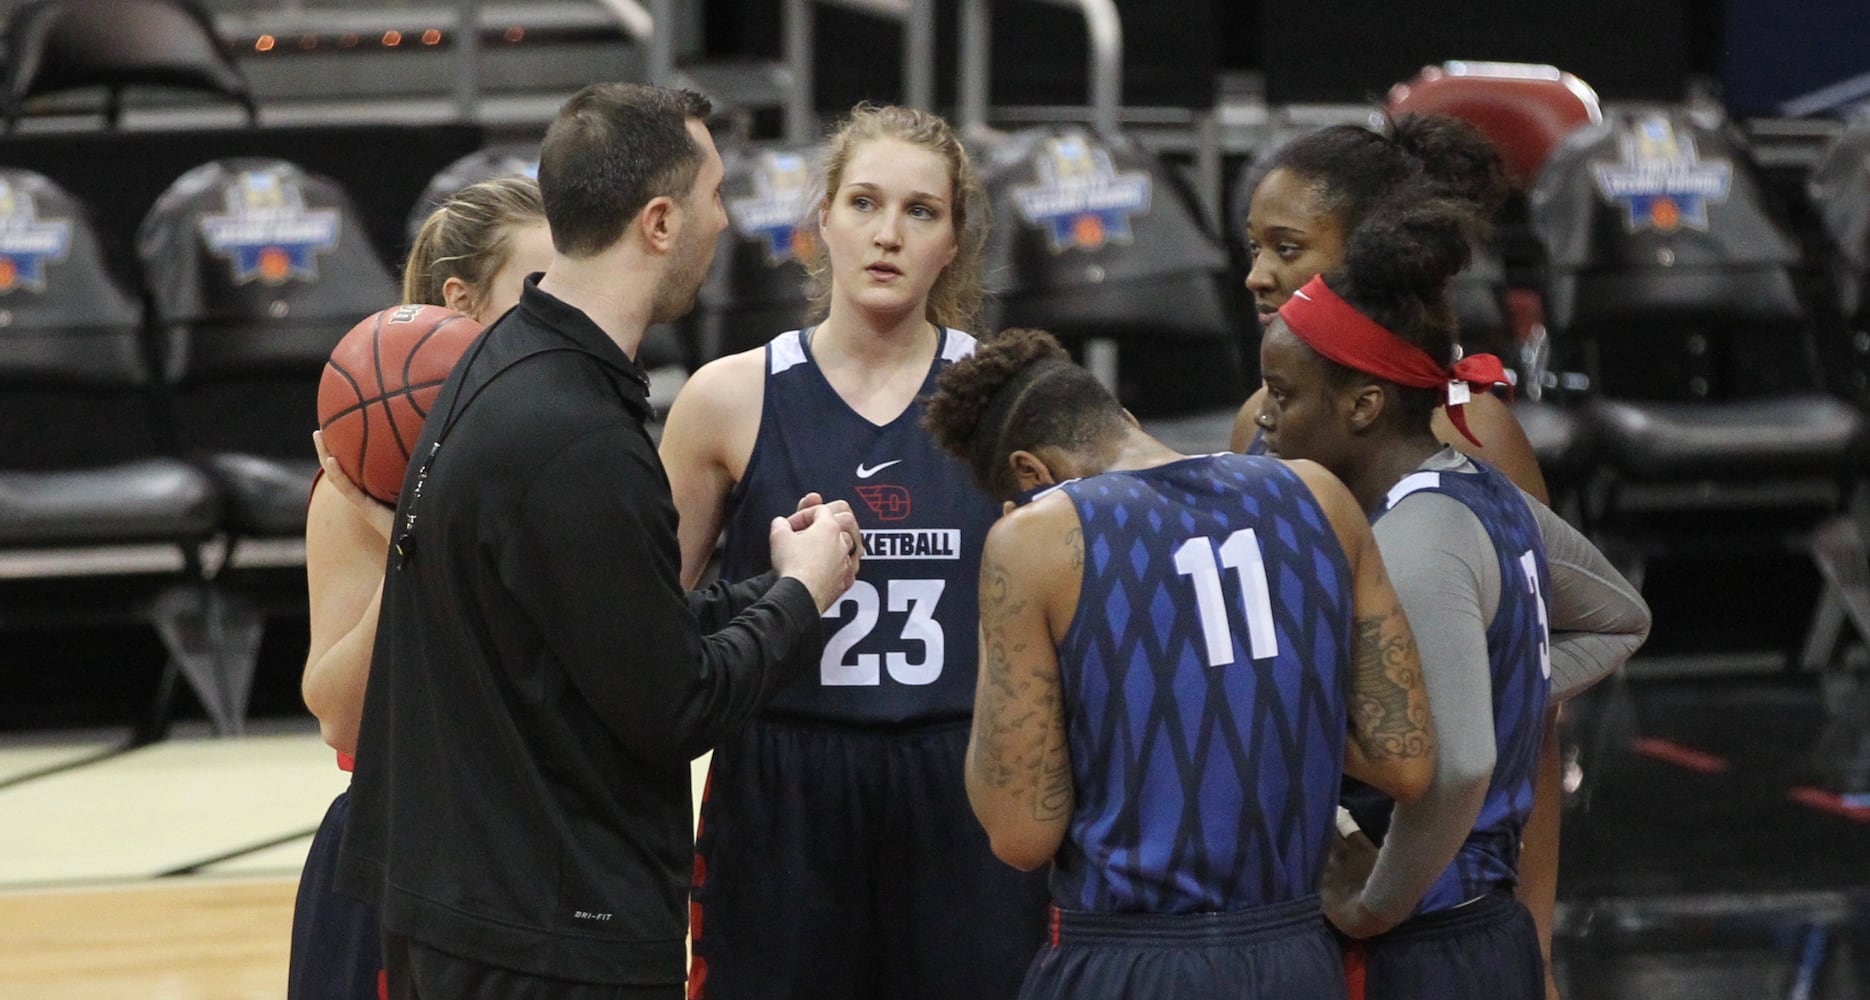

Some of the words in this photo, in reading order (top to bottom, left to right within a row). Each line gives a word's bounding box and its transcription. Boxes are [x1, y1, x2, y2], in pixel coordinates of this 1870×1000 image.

[860, 533, 953, 556] KETBALL
[1174, 528, 1278, 667] 11
[820, 579, 945, 686] 23
[1520, 549, 1551, 680] 3
[574, 910, 613, 920] DRI-FIT
